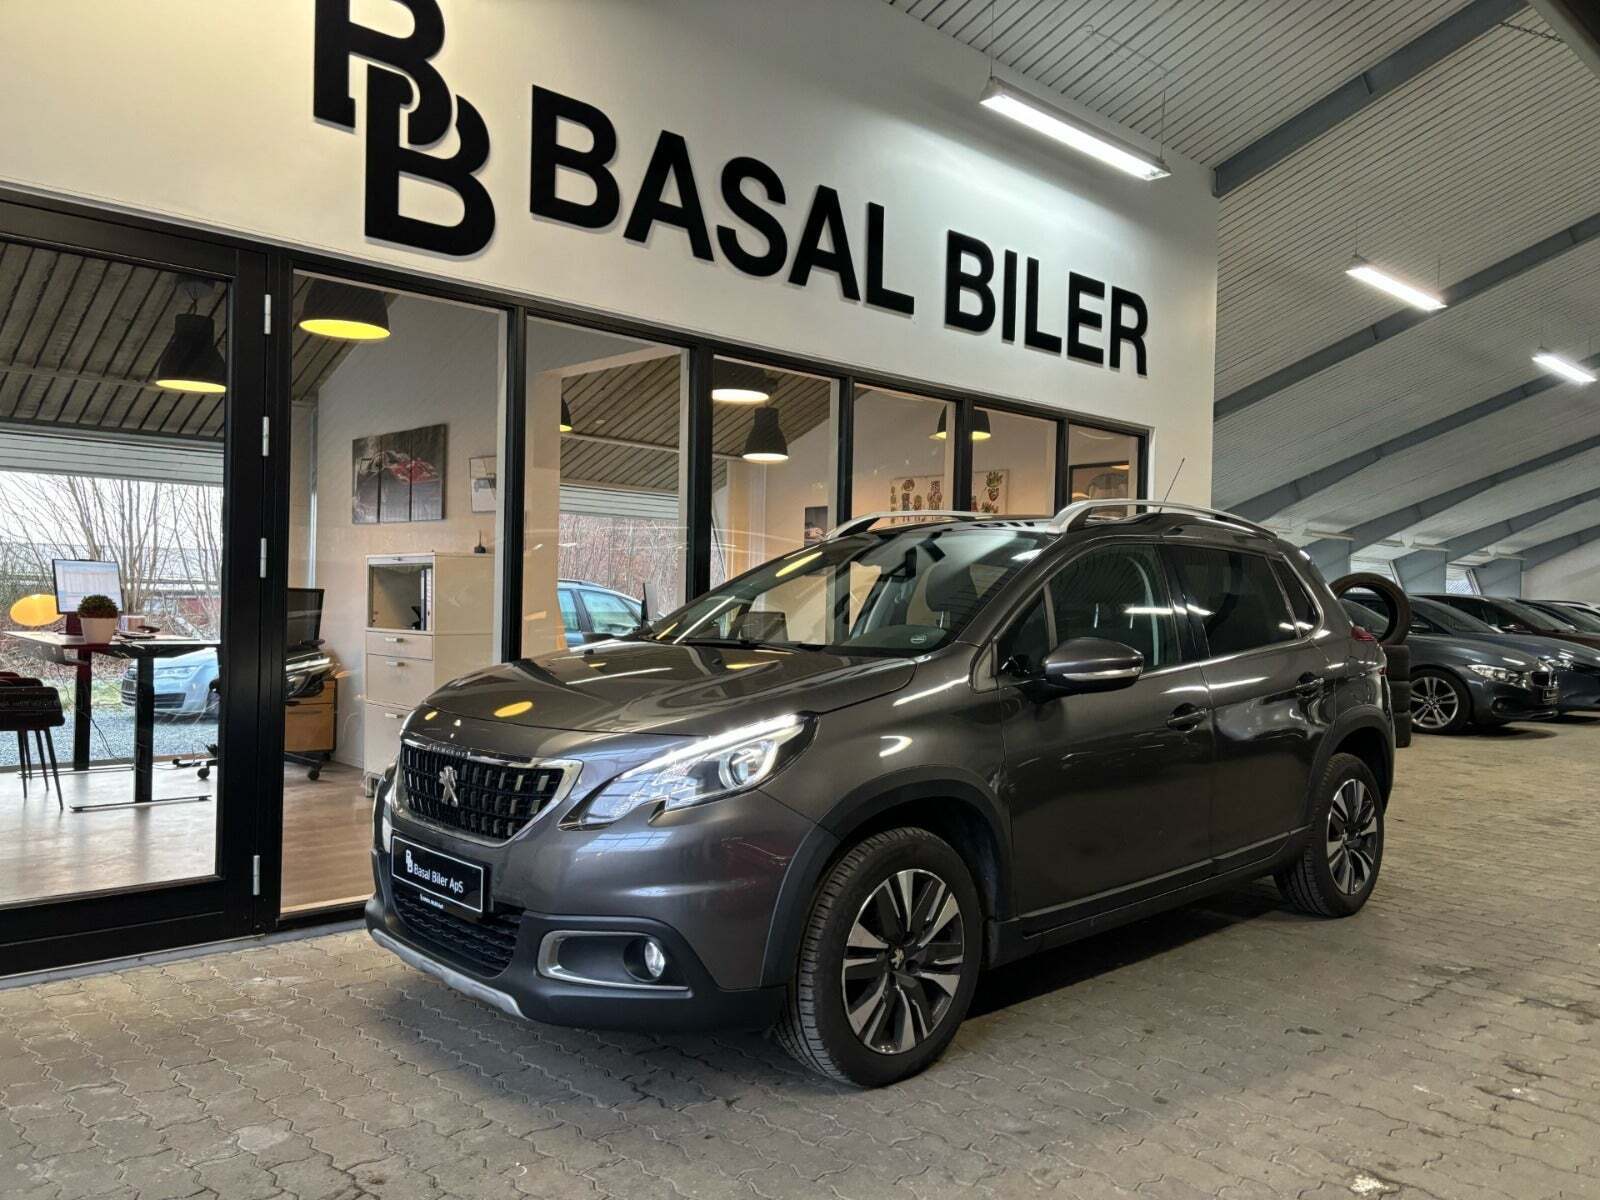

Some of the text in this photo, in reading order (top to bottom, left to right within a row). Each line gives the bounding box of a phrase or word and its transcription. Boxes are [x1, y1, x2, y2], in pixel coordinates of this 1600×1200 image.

[530, 85, 1148, 377] BASAL BILER
[414, 863, 464, 894] Basal Biler ApS
